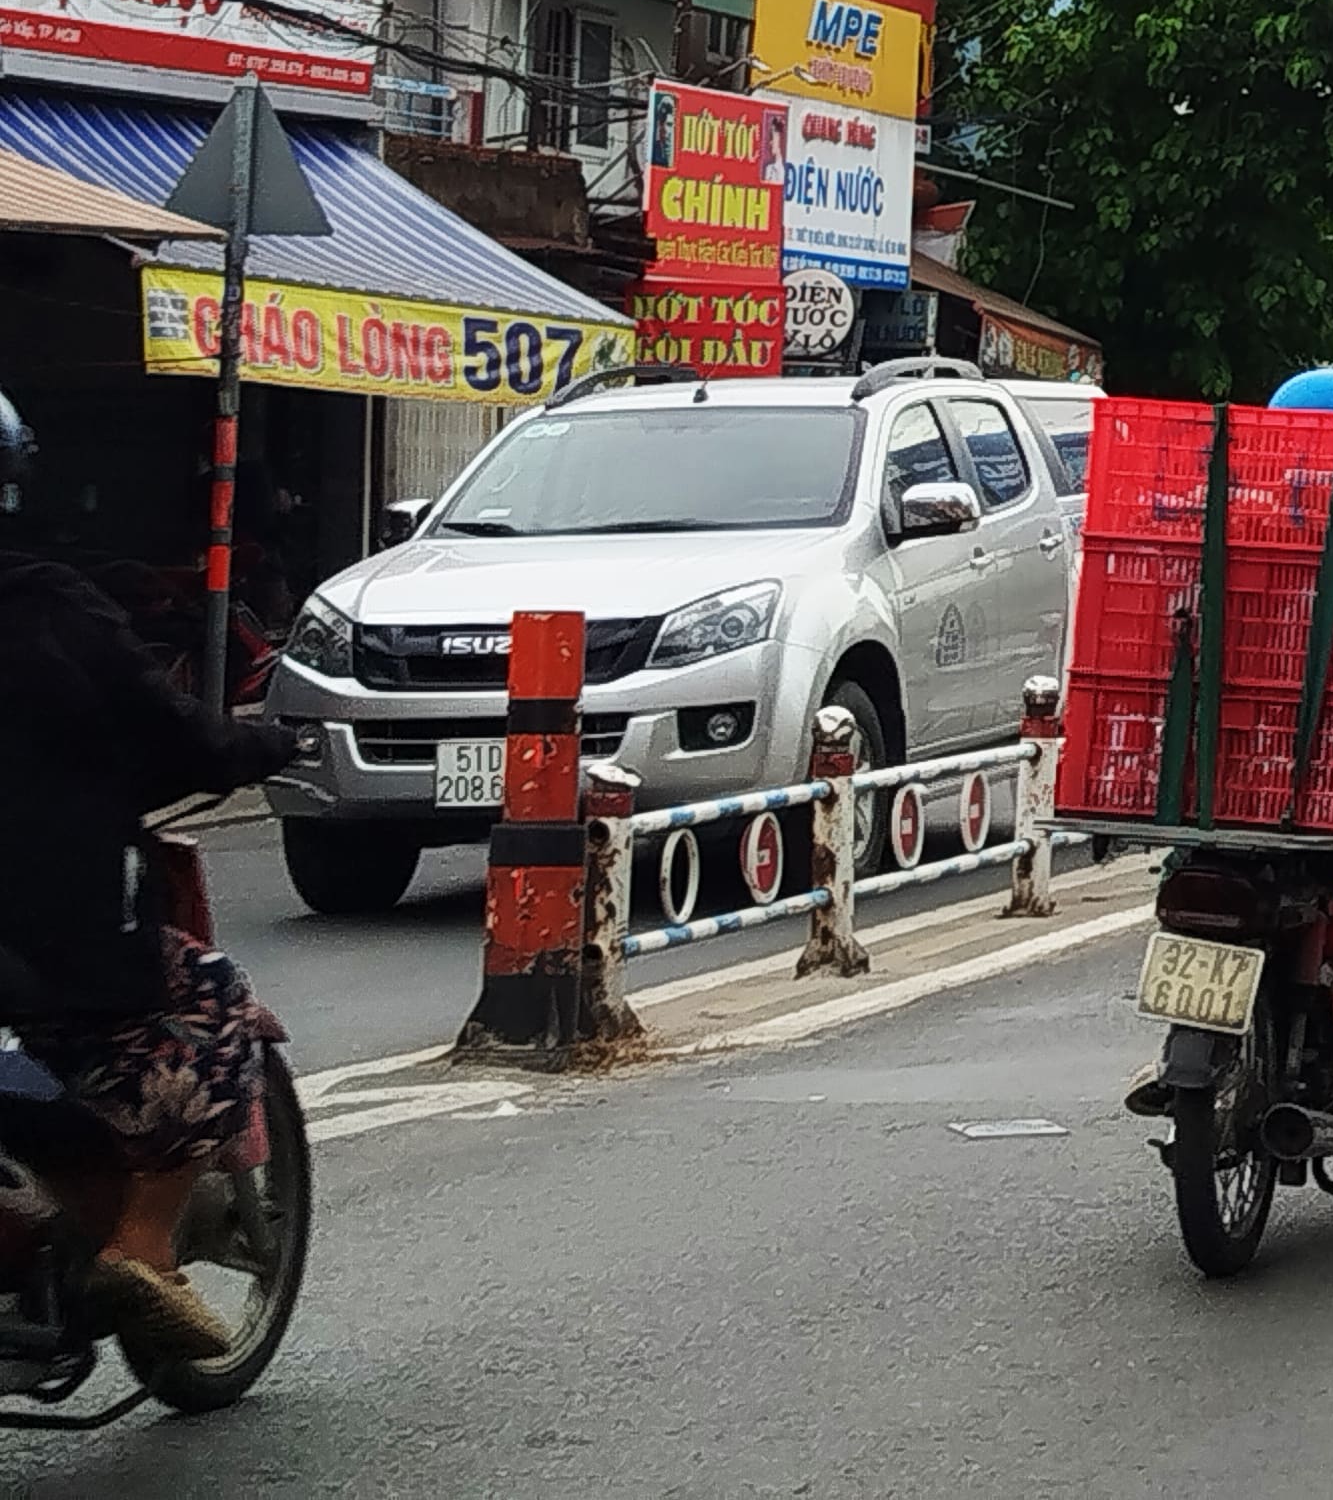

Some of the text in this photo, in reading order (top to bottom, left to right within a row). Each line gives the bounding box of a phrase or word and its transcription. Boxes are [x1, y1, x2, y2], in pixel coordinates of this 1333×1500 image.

[662, 173, 770, 231] CHÍNH
[835, 166, 884, 217] NƯỚC
[711, 290, 780, 328] TÓC
[336, 302, 454, 386] LÒNG
[461, 316, 584, 394] 507
[442, 636, 514, 656] ISUZ
[456, 745, 502, 774] 51D
[438, 775, 504, 803] 208.6
